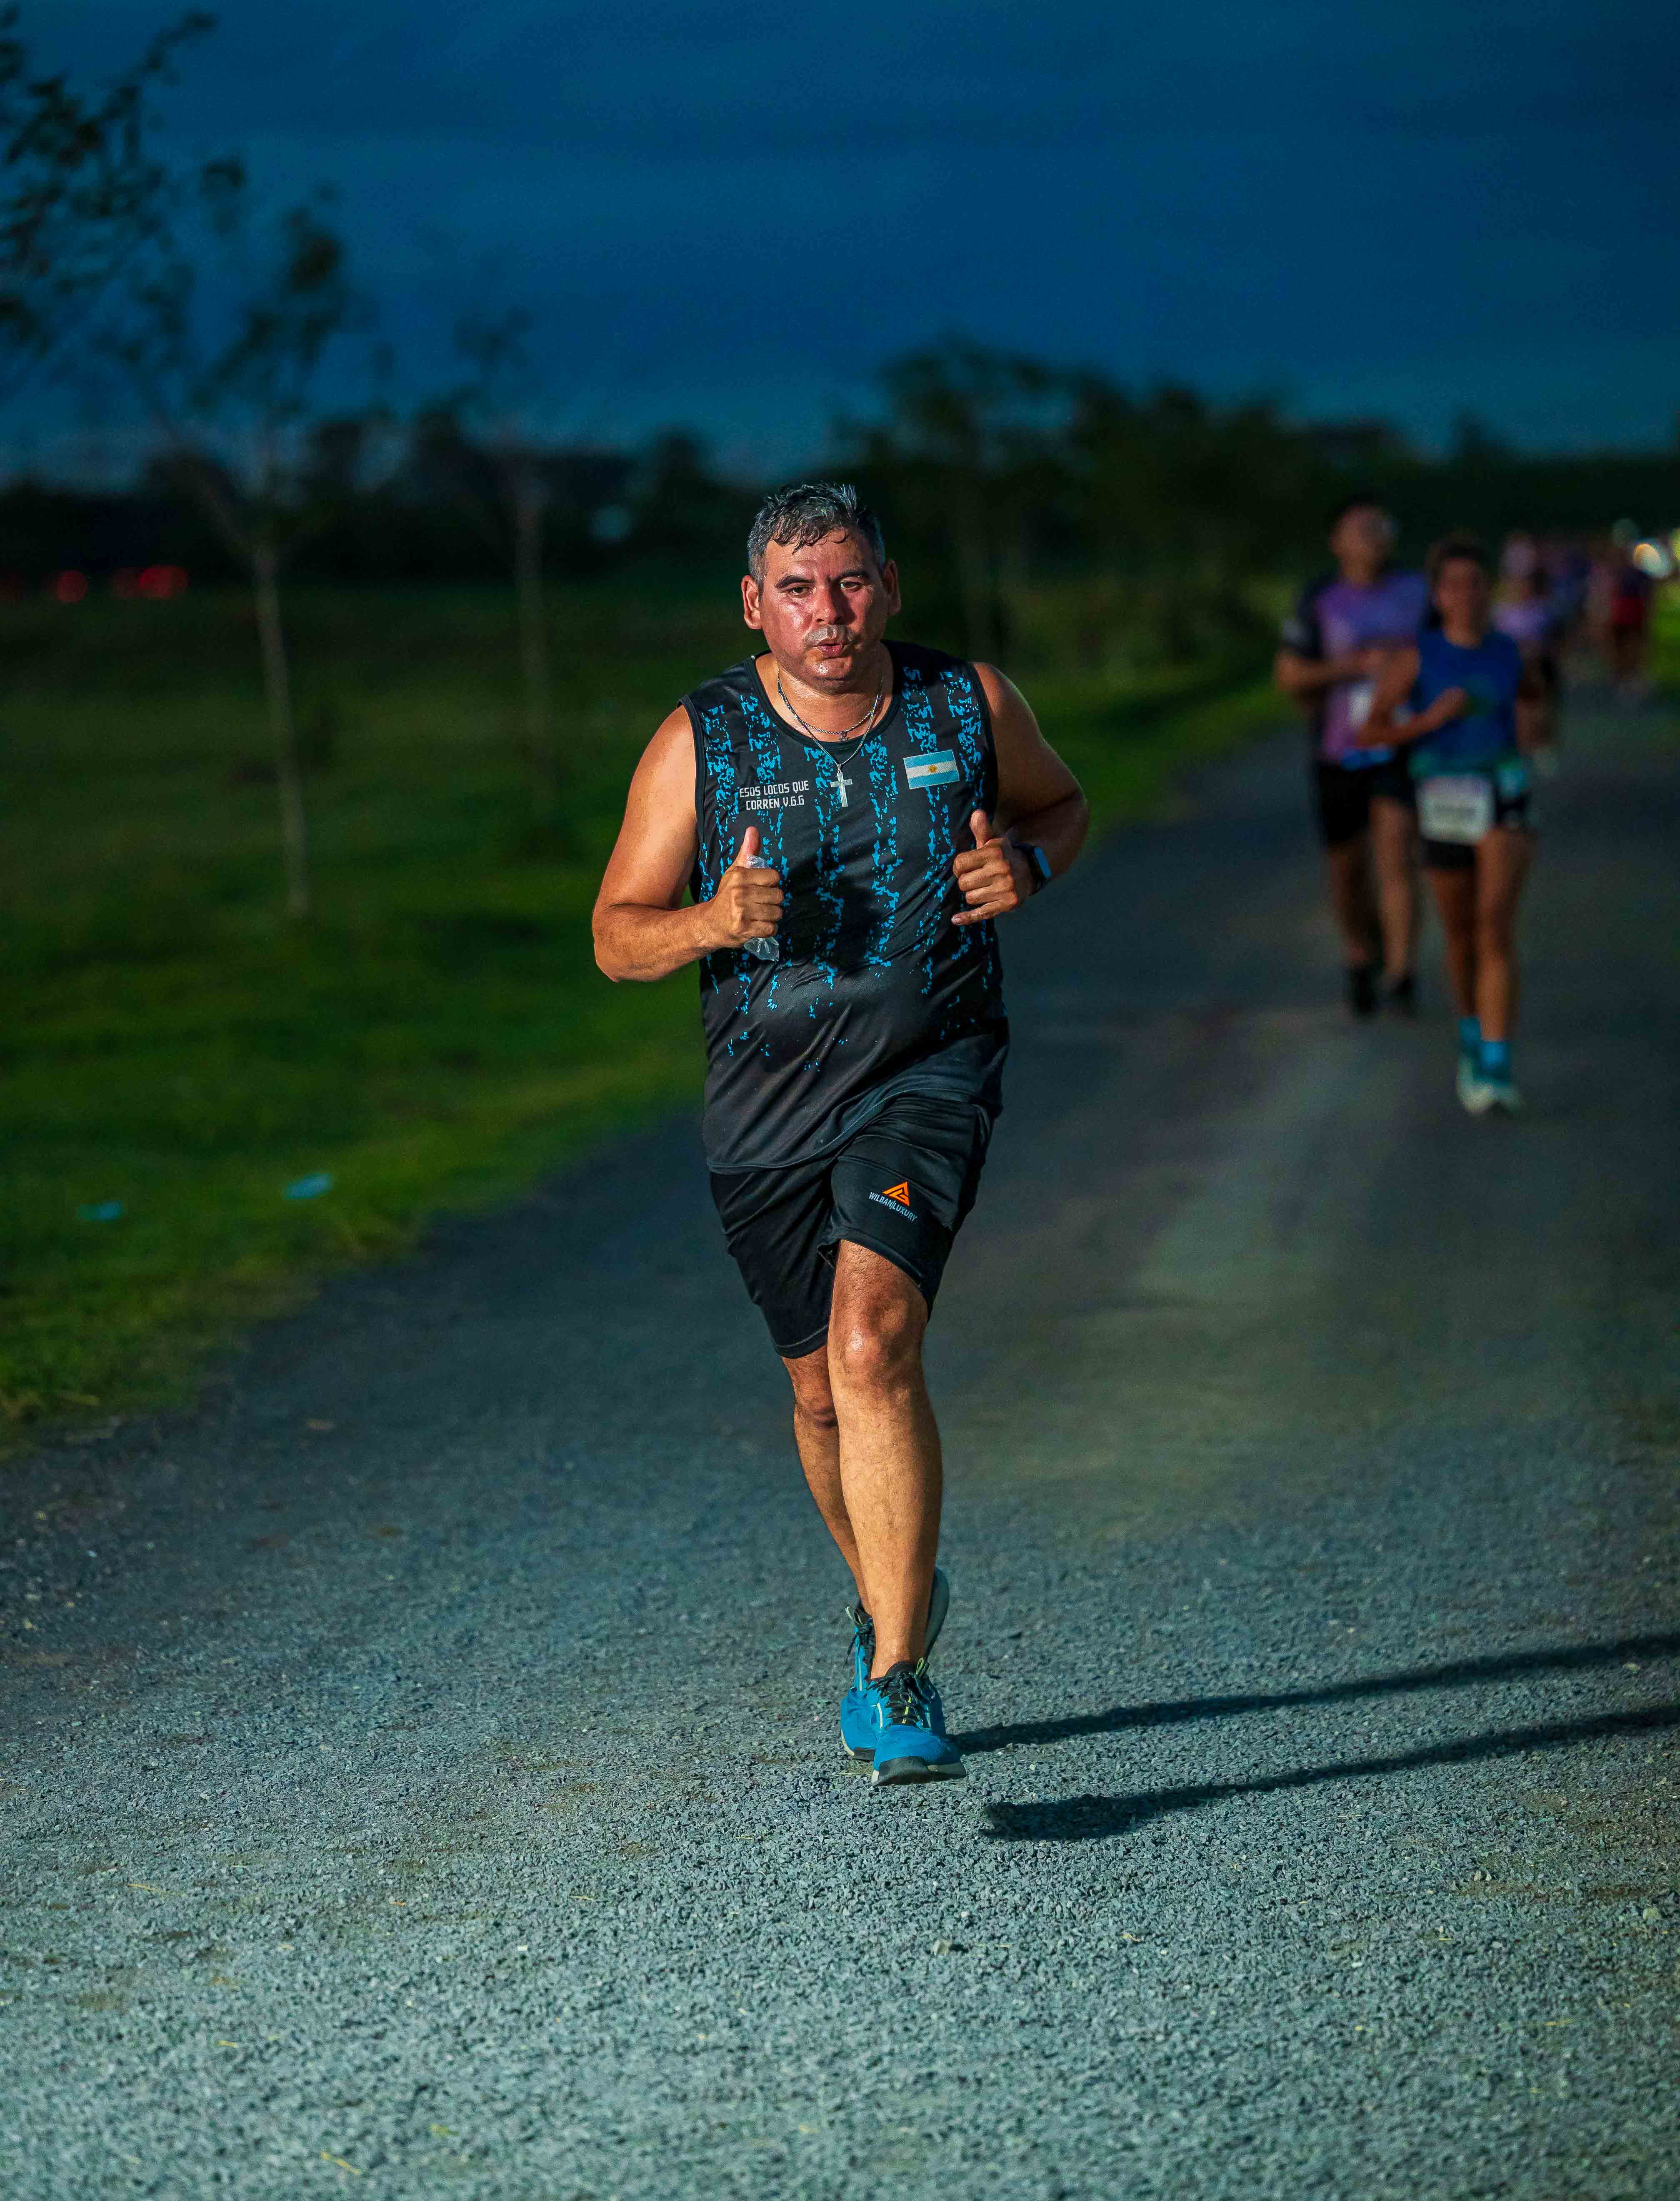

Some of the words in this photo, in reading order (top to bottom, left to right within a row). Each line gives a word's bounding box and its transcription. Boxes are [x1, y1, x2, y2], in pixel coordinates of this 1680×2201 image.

[739, 786, 760, 797] ESOS
[763, 783, 790, 795] LOCOS
[792, 780, 809, 793] QUE
[746, 798, 780, 810] CORREN
